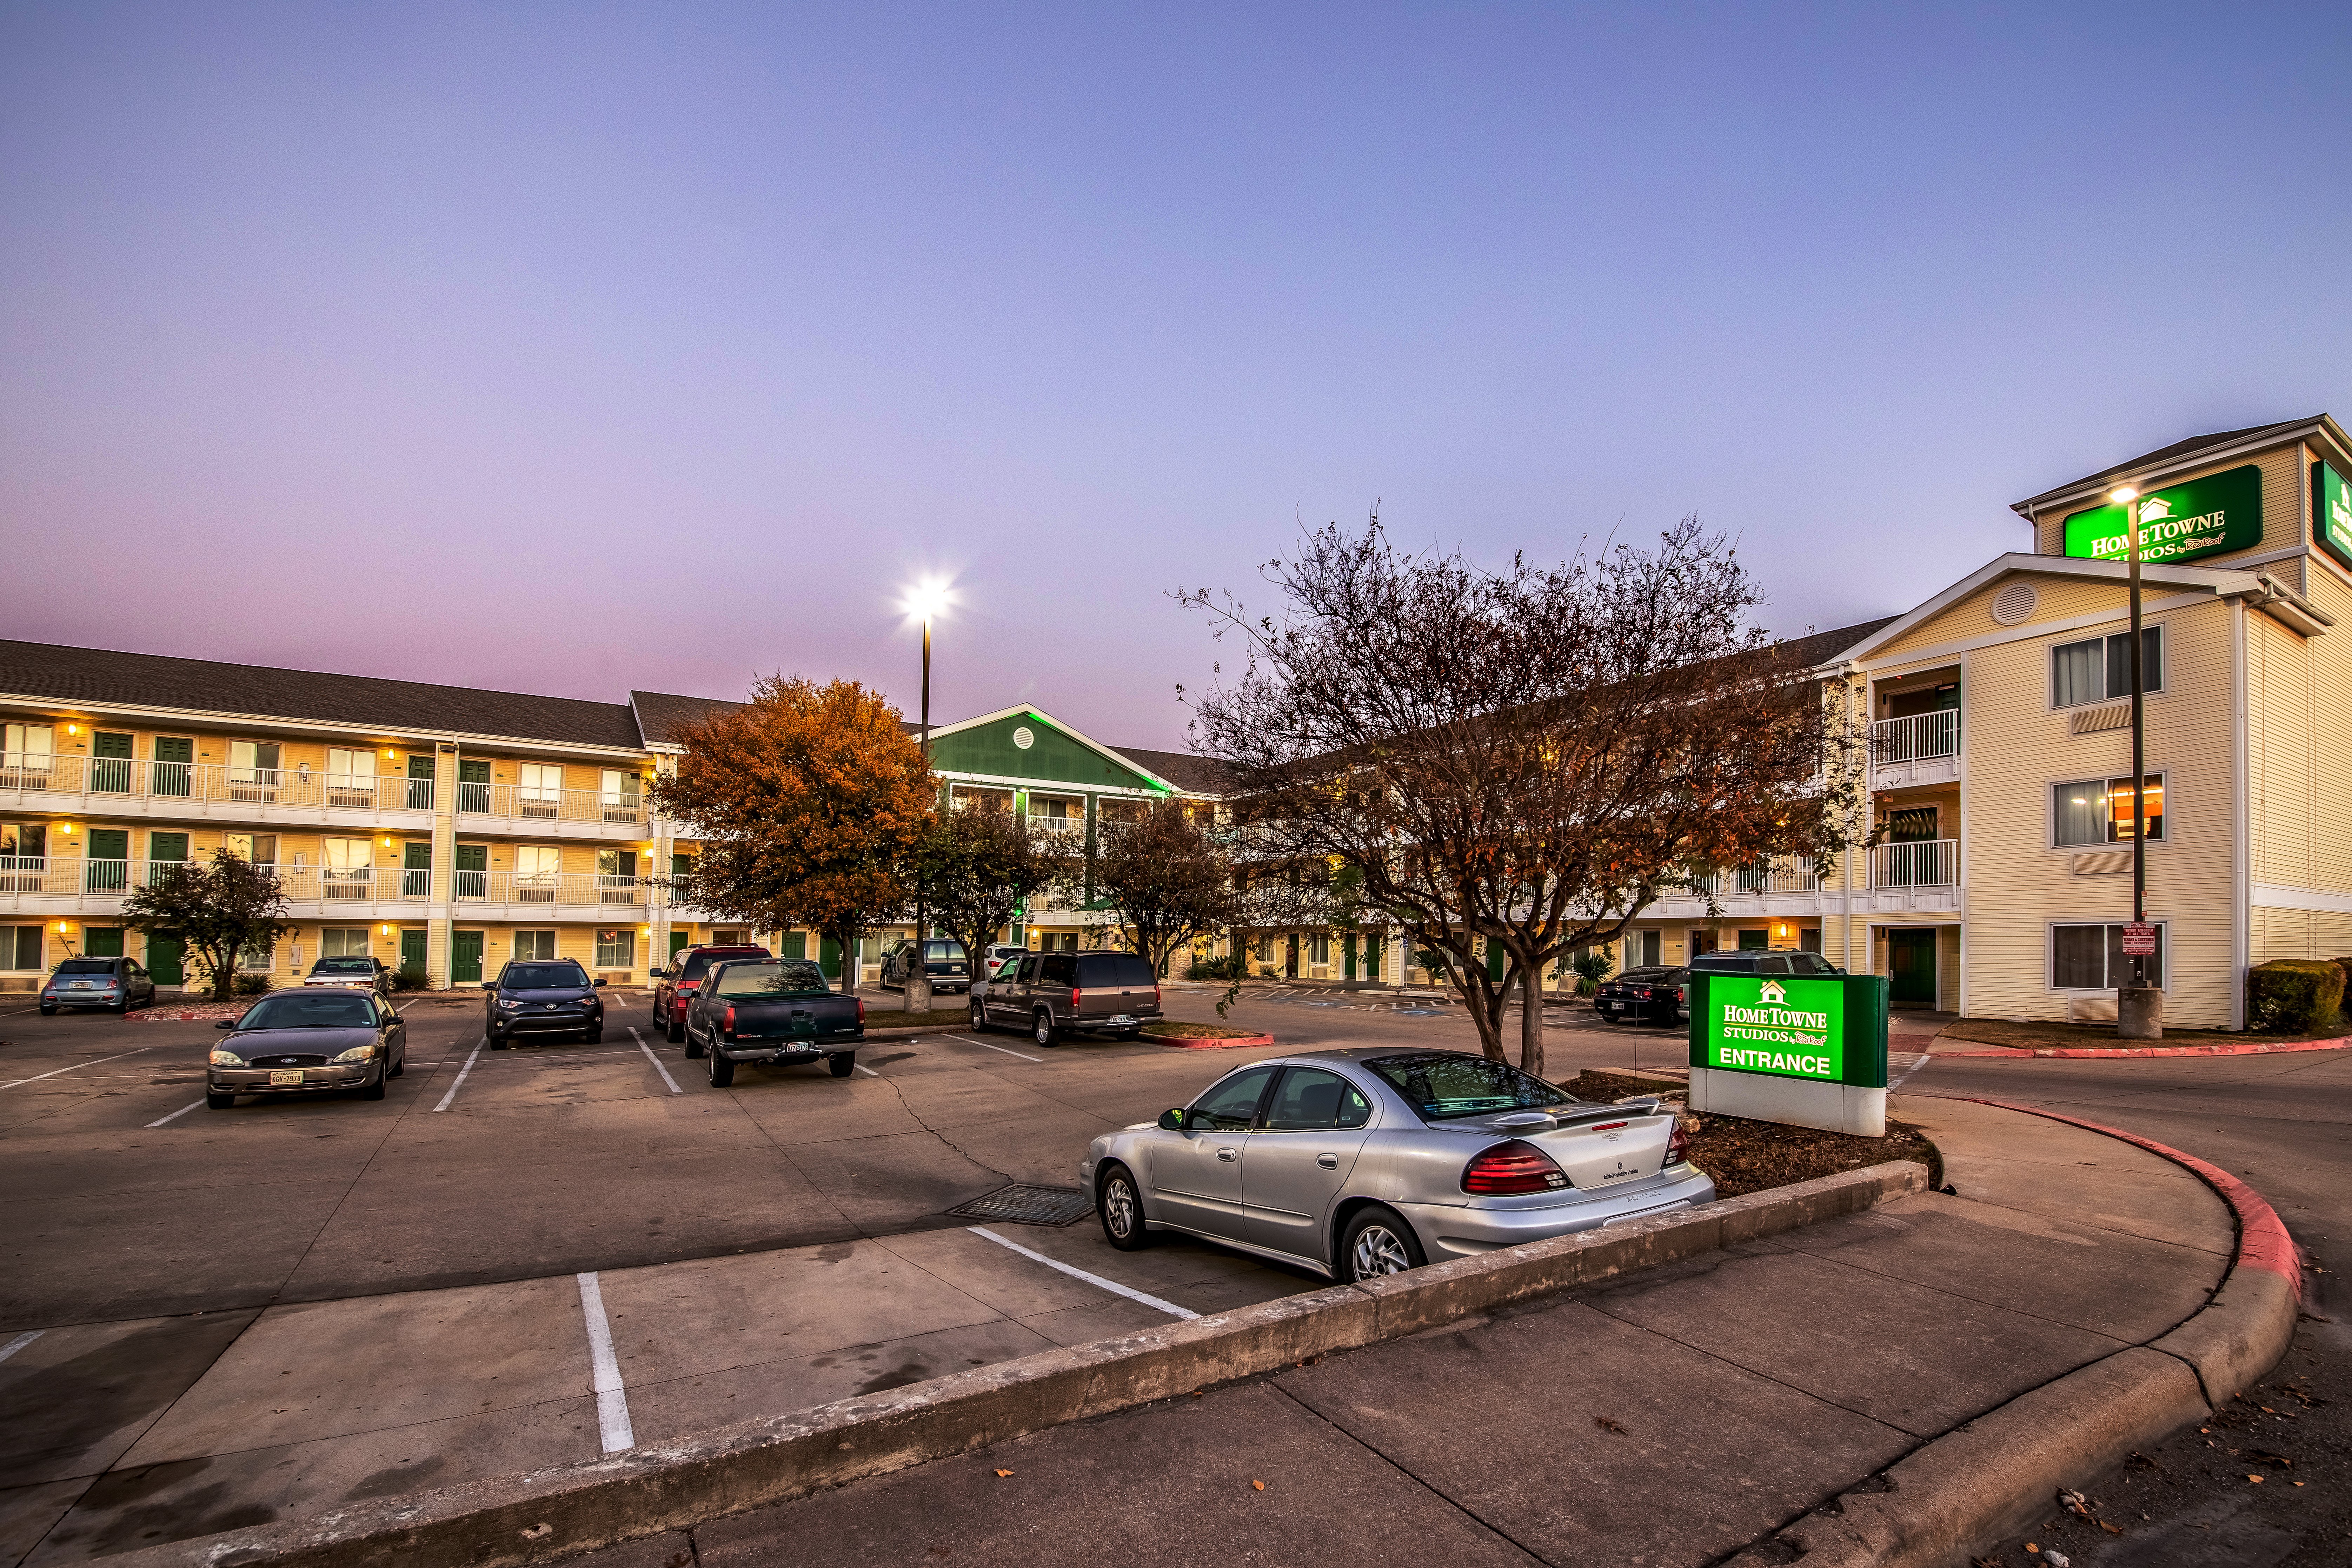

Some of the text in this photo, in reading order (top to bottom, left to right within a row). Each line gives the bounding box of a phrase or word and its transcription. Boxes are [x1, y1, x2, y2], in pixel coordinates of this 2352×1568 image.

[1723, 1027, 1827, 1046] STUDIOS by Red Roof
[1720, 1047, 1830, 1075] ENTRANCE
[1603, 1171, 1628, 1179] GRAND
[1625, 1191, 1661, 1202] PONTIAC
